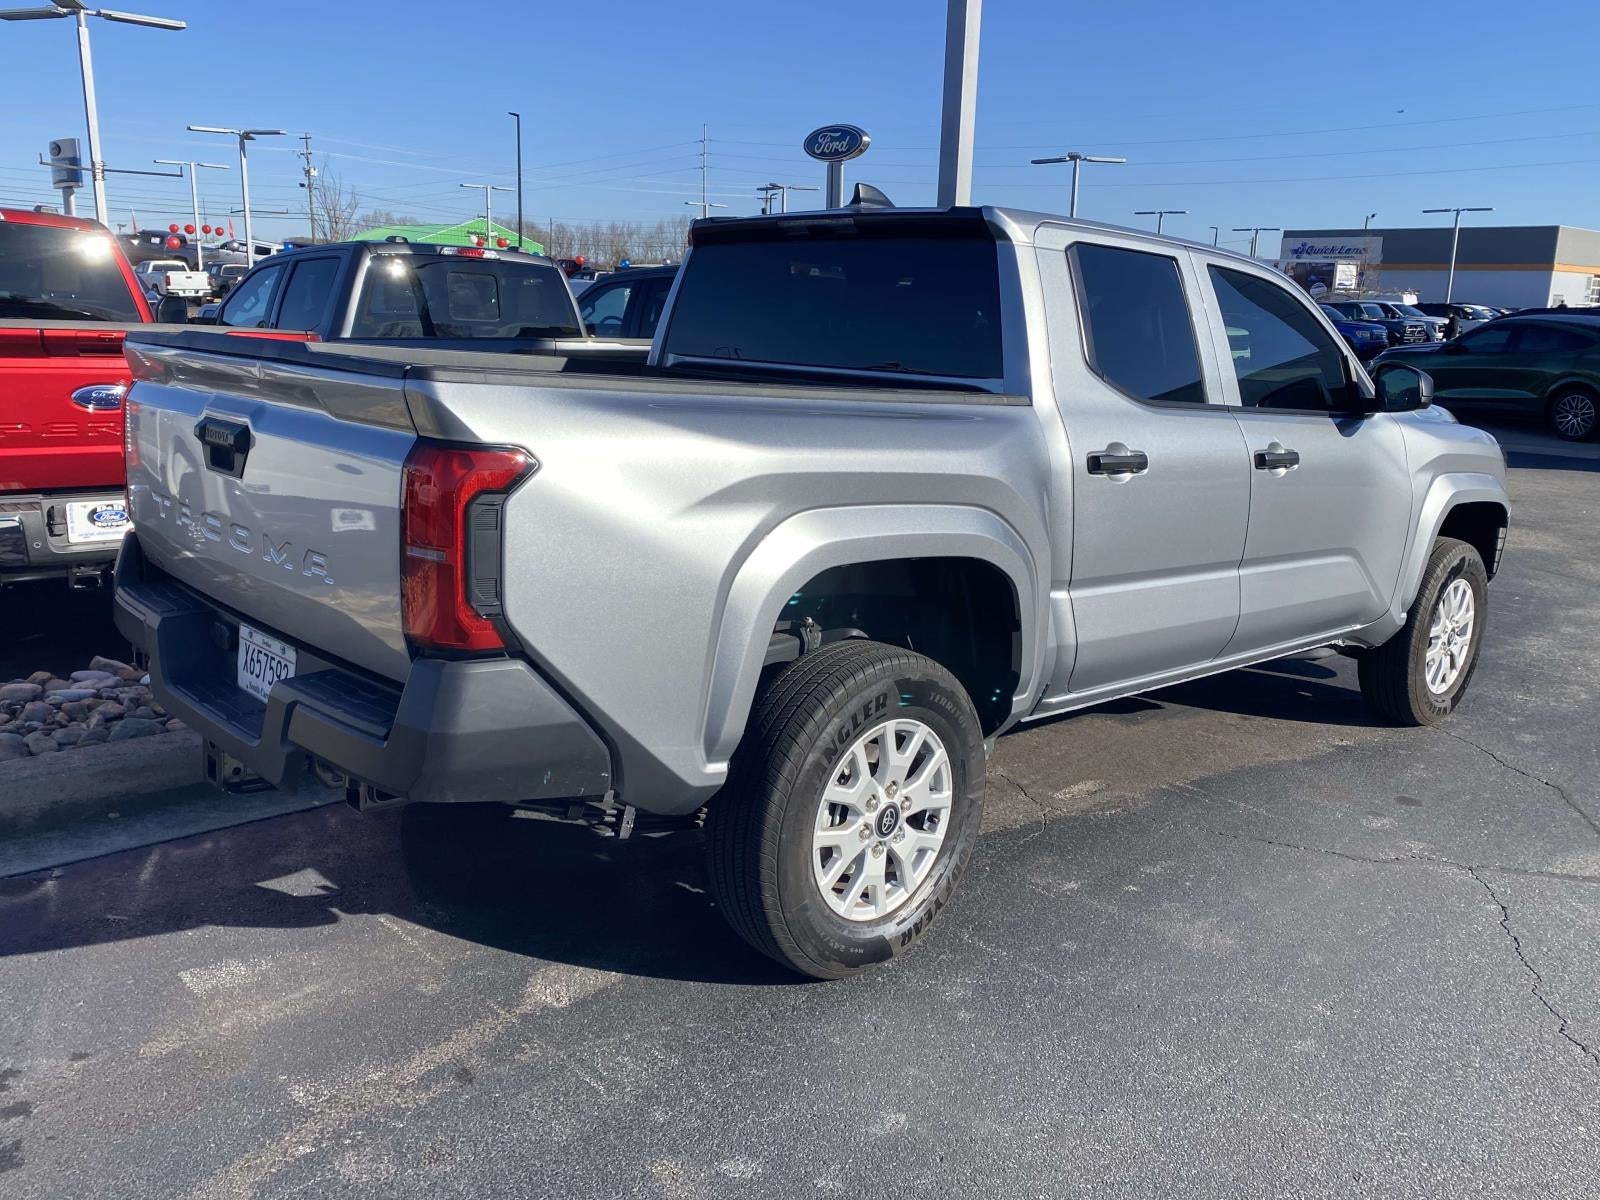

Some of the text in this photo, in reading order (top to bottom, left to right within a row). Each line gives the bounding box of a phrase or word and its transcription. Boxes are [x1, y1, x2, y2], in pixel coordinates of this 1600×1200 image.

[814, 132, 850, 154] Ford
[1305, 245, 1337, 255] Quick
[206, 428, 230, 444] TOYOTA
[151, 491, 336, 585] TACOMA
